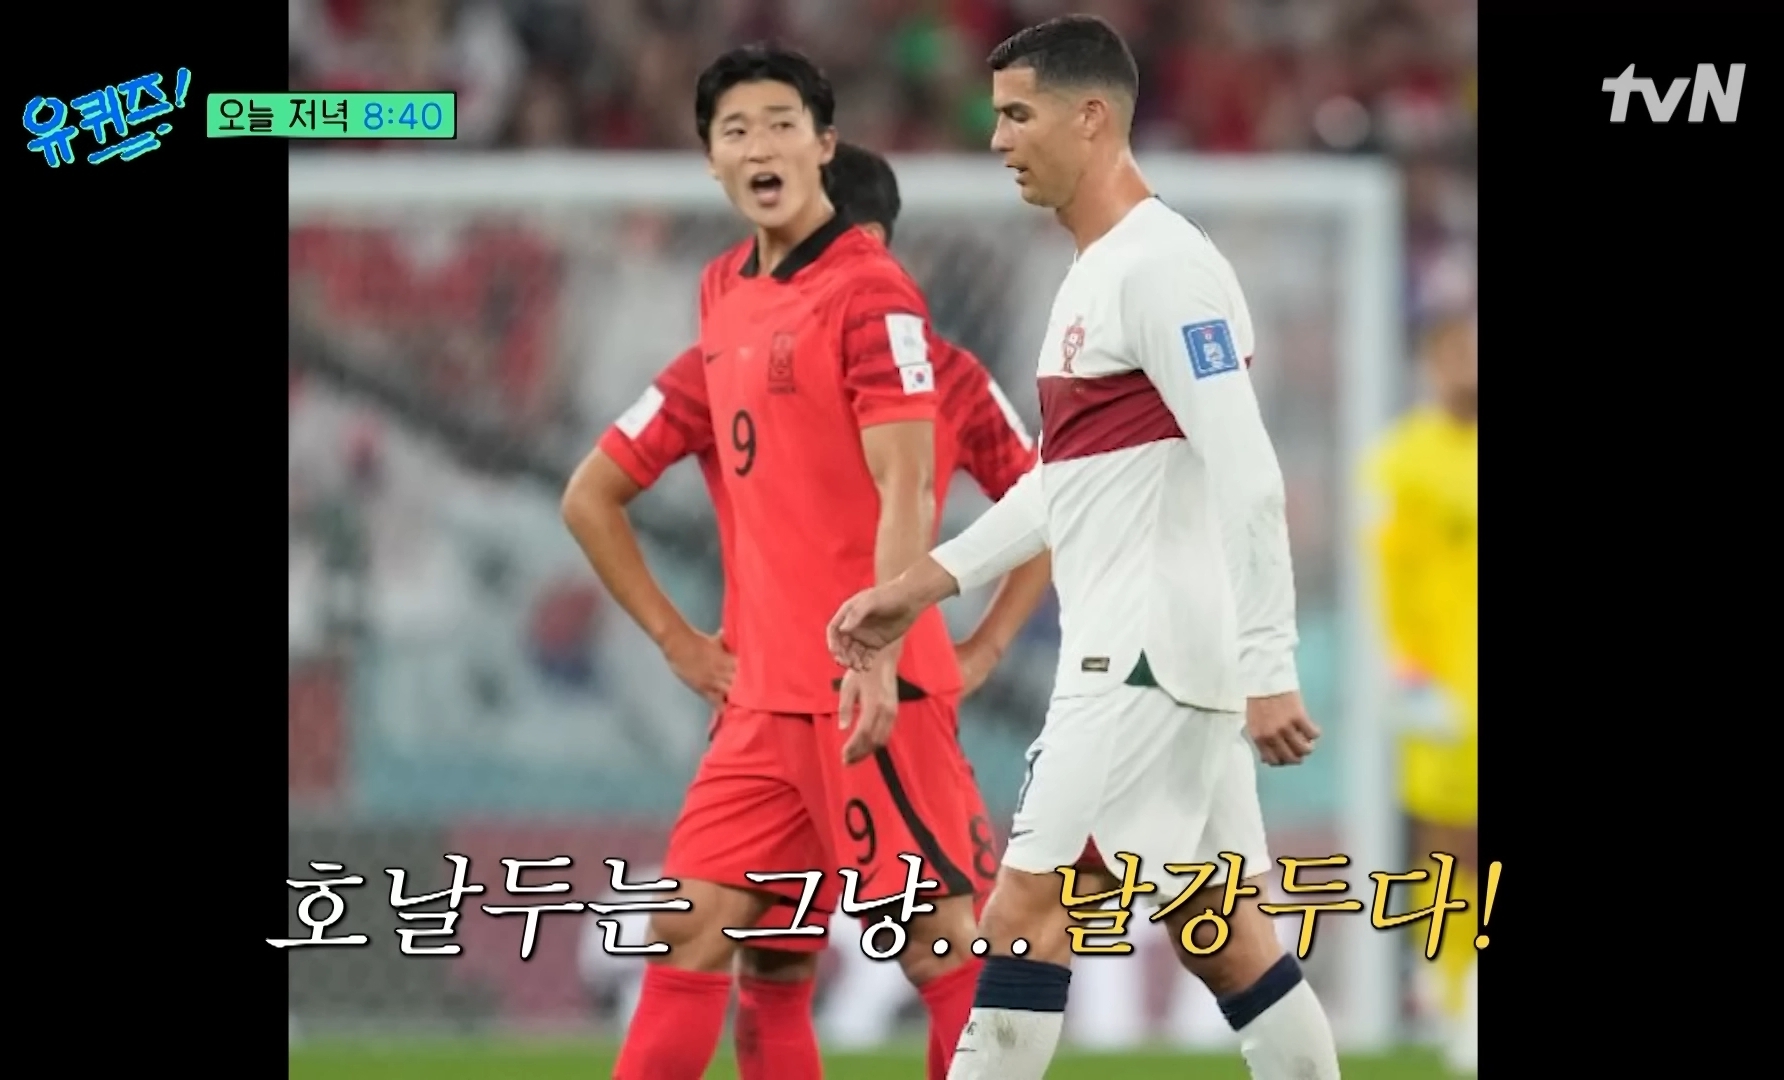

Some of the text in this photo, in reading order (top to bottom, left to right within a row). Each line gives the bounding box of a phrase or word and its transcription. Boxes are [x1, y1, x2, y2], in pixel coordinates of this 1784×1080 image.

[732, 409, 757, 477] 9
[844, 798, 877, 864] 9
[969, 815, 998, 880] 8
